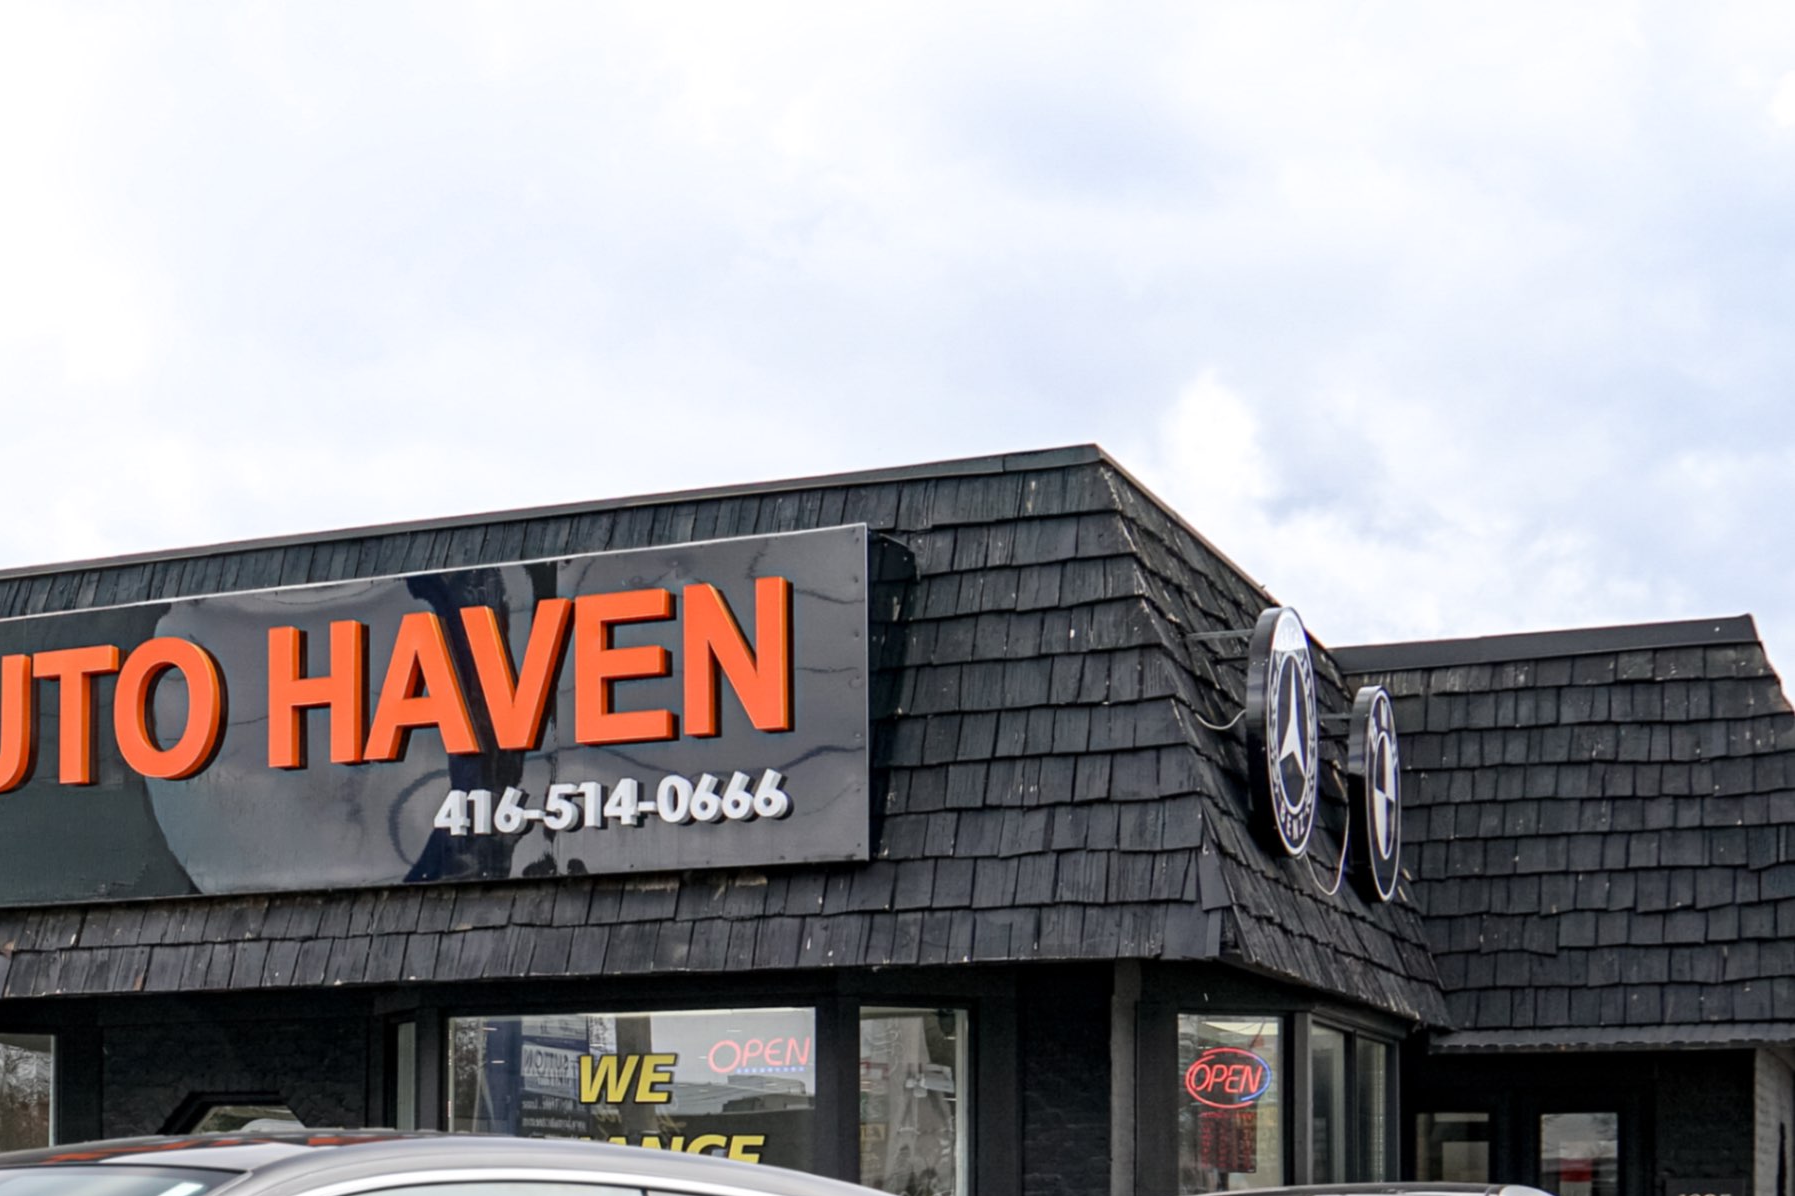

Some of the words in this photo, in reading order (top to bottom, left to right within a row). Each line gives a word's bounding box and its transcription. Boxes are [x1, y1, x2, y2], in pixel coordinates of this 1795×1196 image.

[269, 576, 794, 768] HAVEN
[434, 768, 789, 837] 416-514-0666
[579, 1053, 678, 1104] WE
[708, 1036, 810, 1074] OPEN
[1190, 1063, 1263, 1094] OPEN
